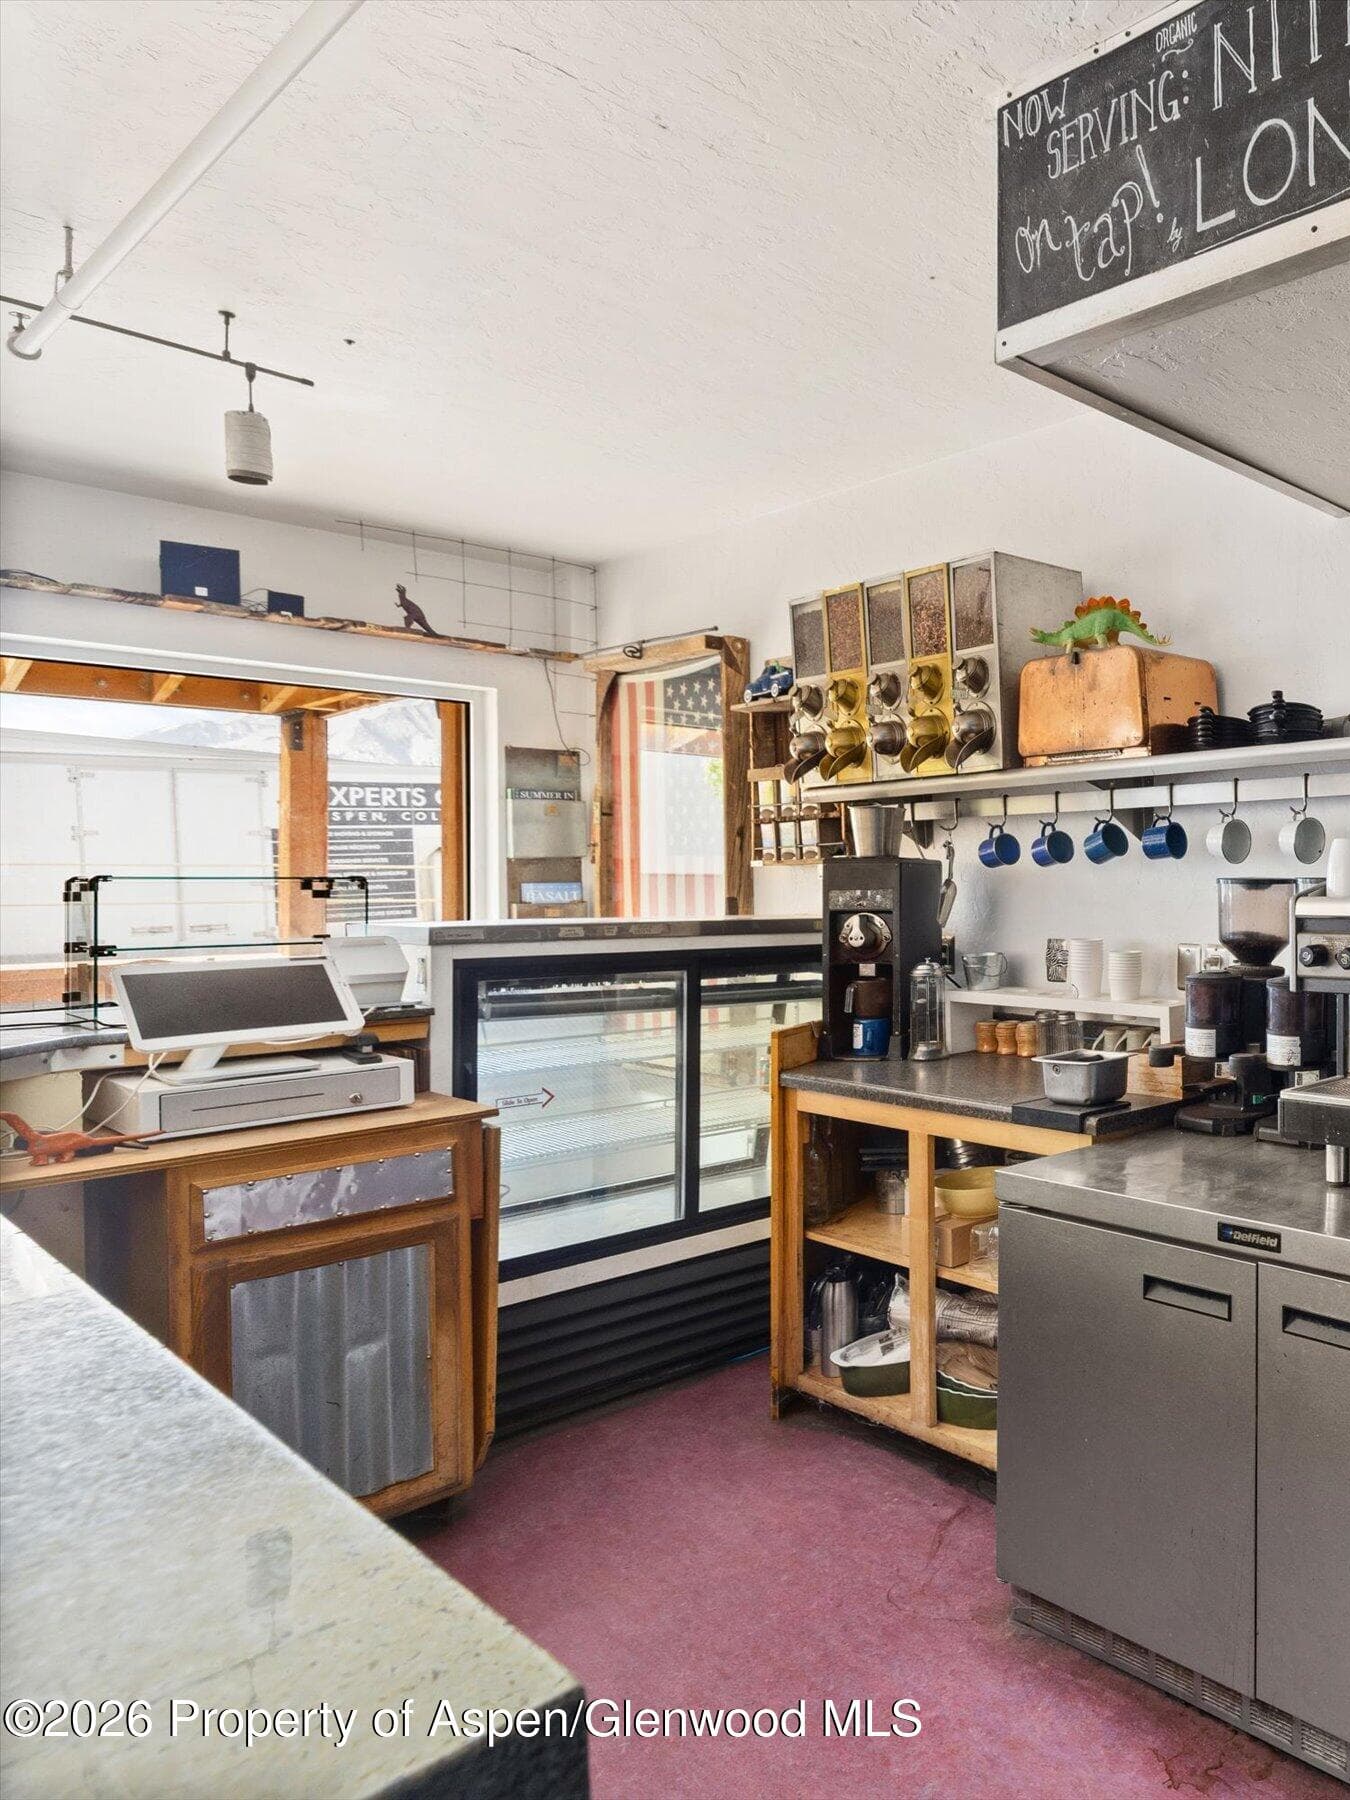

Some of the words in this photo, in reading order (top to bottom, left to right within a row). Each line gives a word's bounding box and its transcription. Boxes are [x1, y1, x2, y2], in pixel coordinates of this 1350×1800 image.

[1155, 11, 1198, 52] ORGANIC
[1002, 77, 1070, 147] NOW
[1046, 69, 1190, 179] SERVING:
[328, 786, 427, 807] XPERTS
[519, 790, 562, 800] SUMMER
[563, 791, 575, 800] IN
[331, 811, 387, 823] SPEN,
[401, 811, 438, 821] COL
[1233, 1230, 1278, 1247] Delfield
